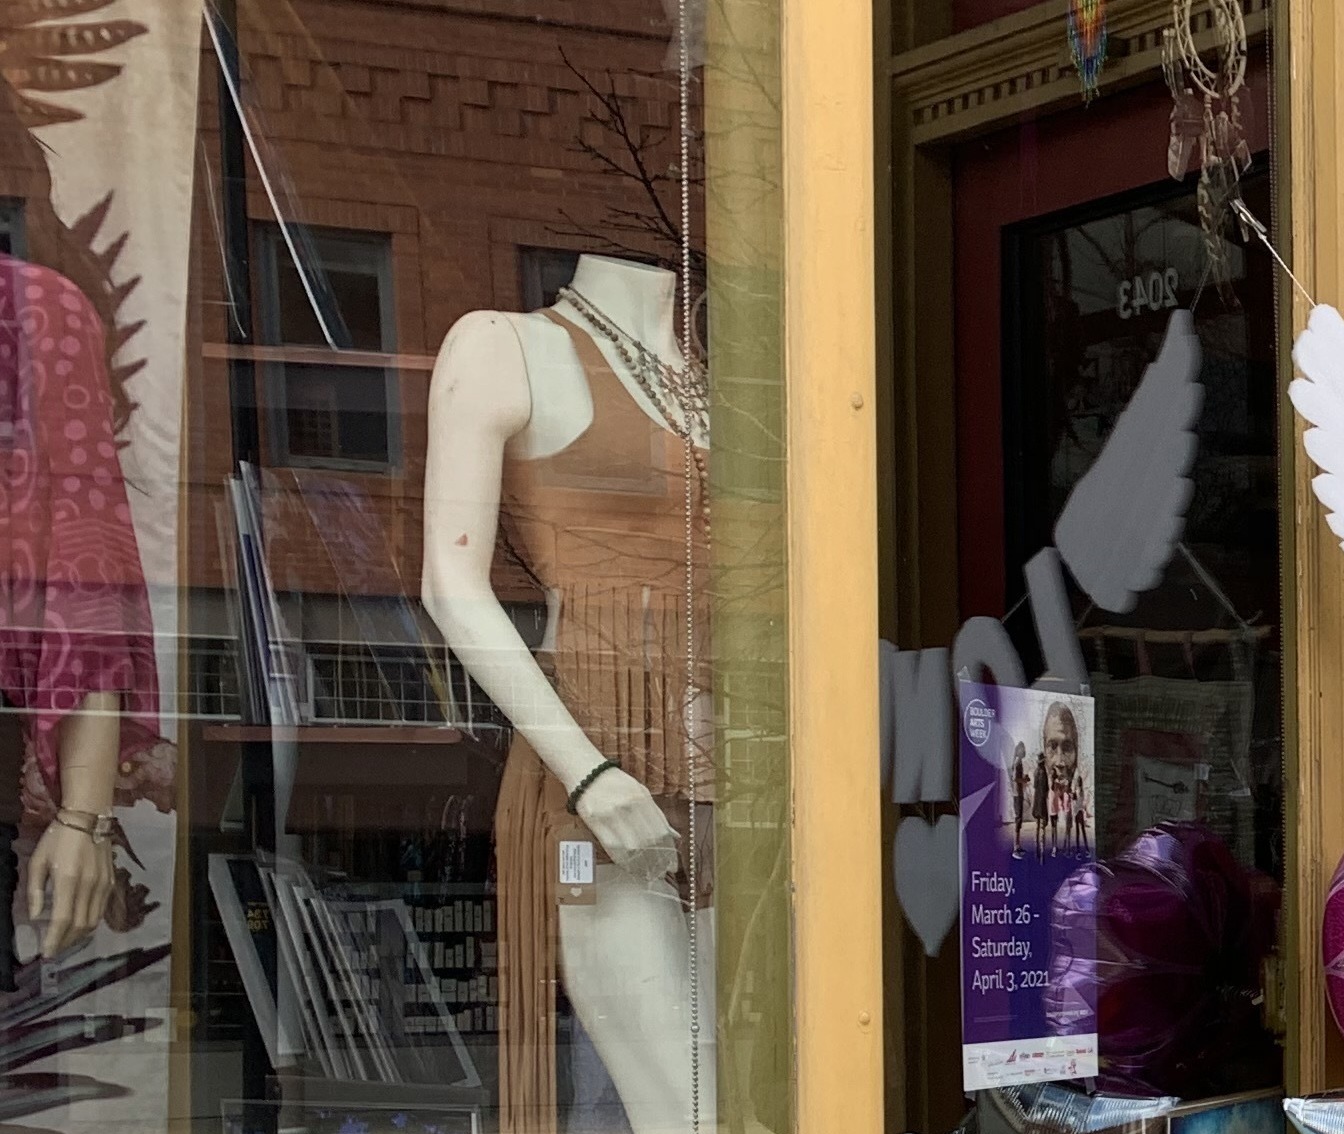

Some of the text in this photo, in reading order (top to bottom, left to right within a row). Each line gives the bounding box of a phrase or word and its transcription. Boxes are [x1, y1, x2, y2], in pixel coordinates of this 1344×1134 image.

[969, 707, 996, 718] BOULDER
[969, 719, 985, 729] ARTS
[970, 728, 987, 738] WEEK
[971, 871, 1016, 897] Friday,
[971, 904, 1013, 924] March
[1015, 904, 1031, 924] 26
[971, 936, 1032, 961] Saturday,
[972, 969, 1050, 995] April 3, 2021
